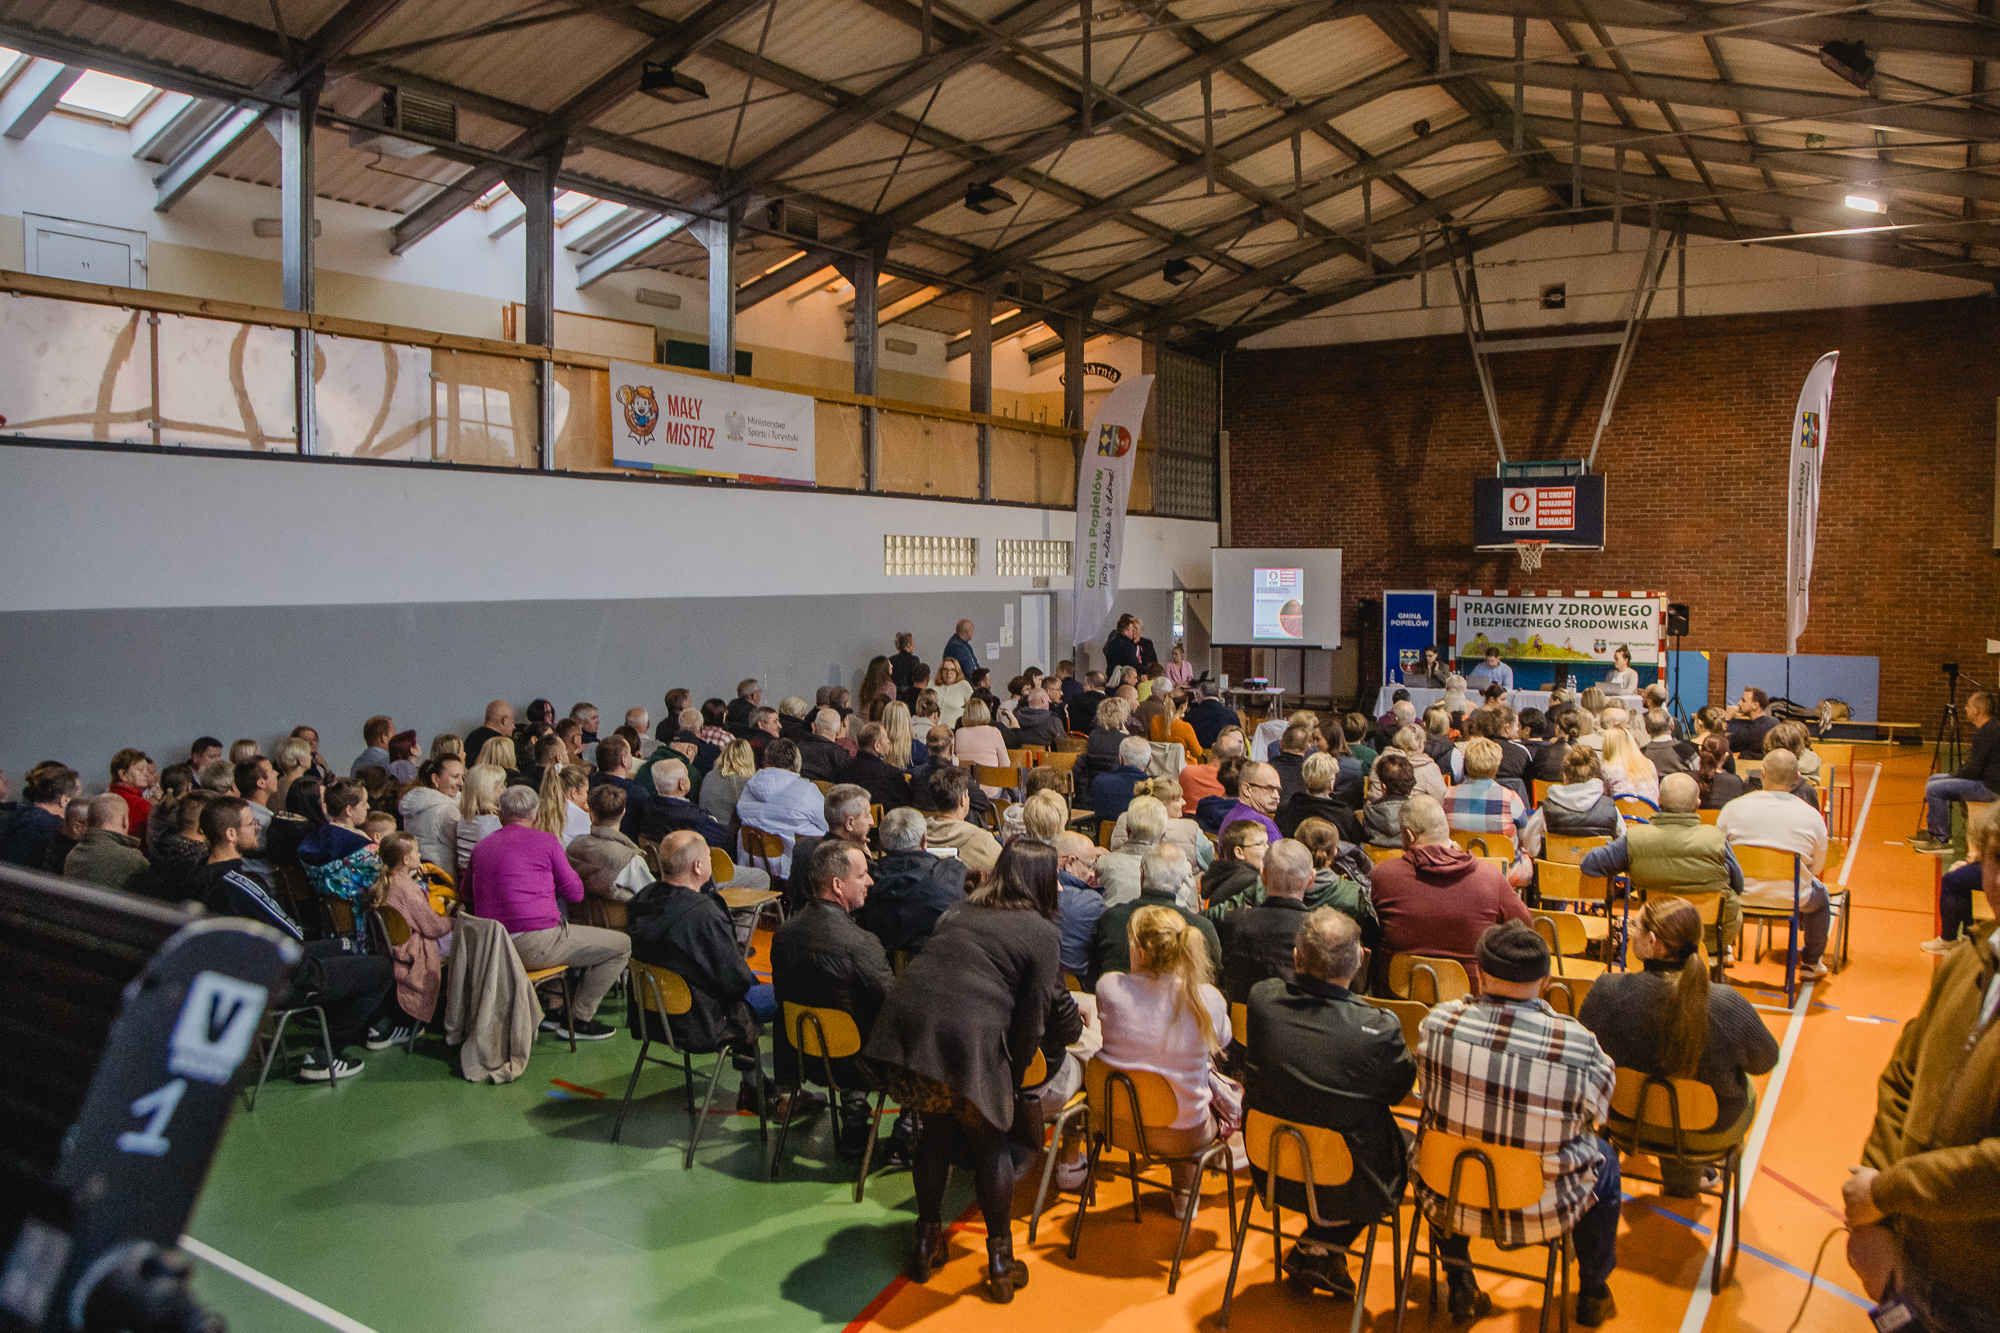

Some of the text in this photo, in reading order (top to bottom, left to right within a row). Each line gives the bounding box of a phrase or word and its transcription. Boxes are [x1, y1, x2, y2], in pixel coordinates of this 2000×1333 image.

[667, 394, 702, 420] MAŁY
[747, 416, 786, 429] Ministerstwo
[666, 421, 715, 450] MISTRZ
[747, 427, 767, 438] Sportu
[772, 430, 799, 441] Turystyki
[1508, 516, 1530, 526] STOP
[1086, 469, 1103, 588] Gmina Popielów
[1464, 602, 1652, 616] PRAGNIEMY ZDROWEGO
[1390, 619, 1429, 627] POPIELÓW
[1467, 617, 1648, 630] I BEZPIECZNEGO ŚRODOWISKA
